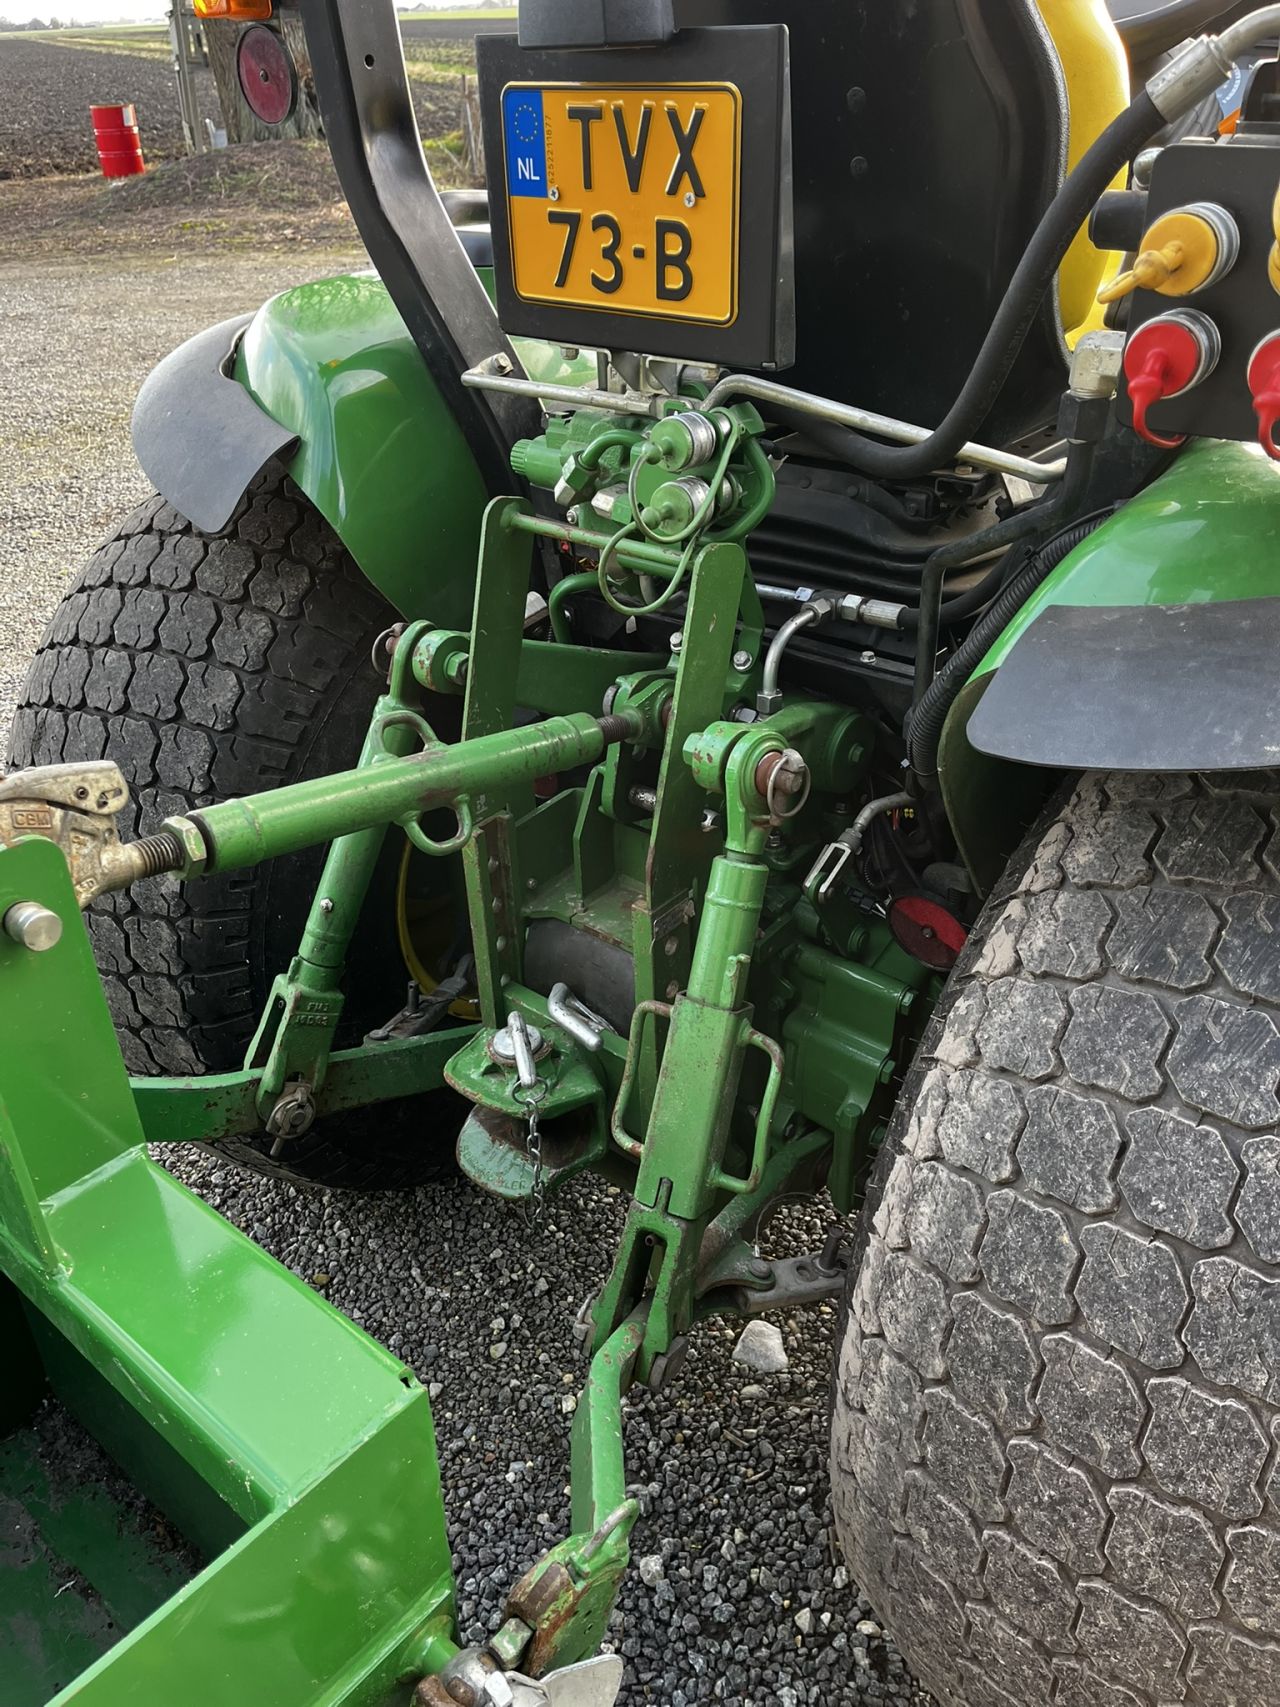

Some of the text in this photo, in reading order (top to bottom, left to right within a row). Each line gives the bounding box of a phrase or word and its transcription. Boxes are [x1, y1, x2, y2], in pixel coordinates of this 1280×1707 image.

[517, 157, 540, 181] NL
[567, 106, 706, 198] TVX
[548, 210, 693, 301] 73-B
[15, 813, 49, 826] CBM
